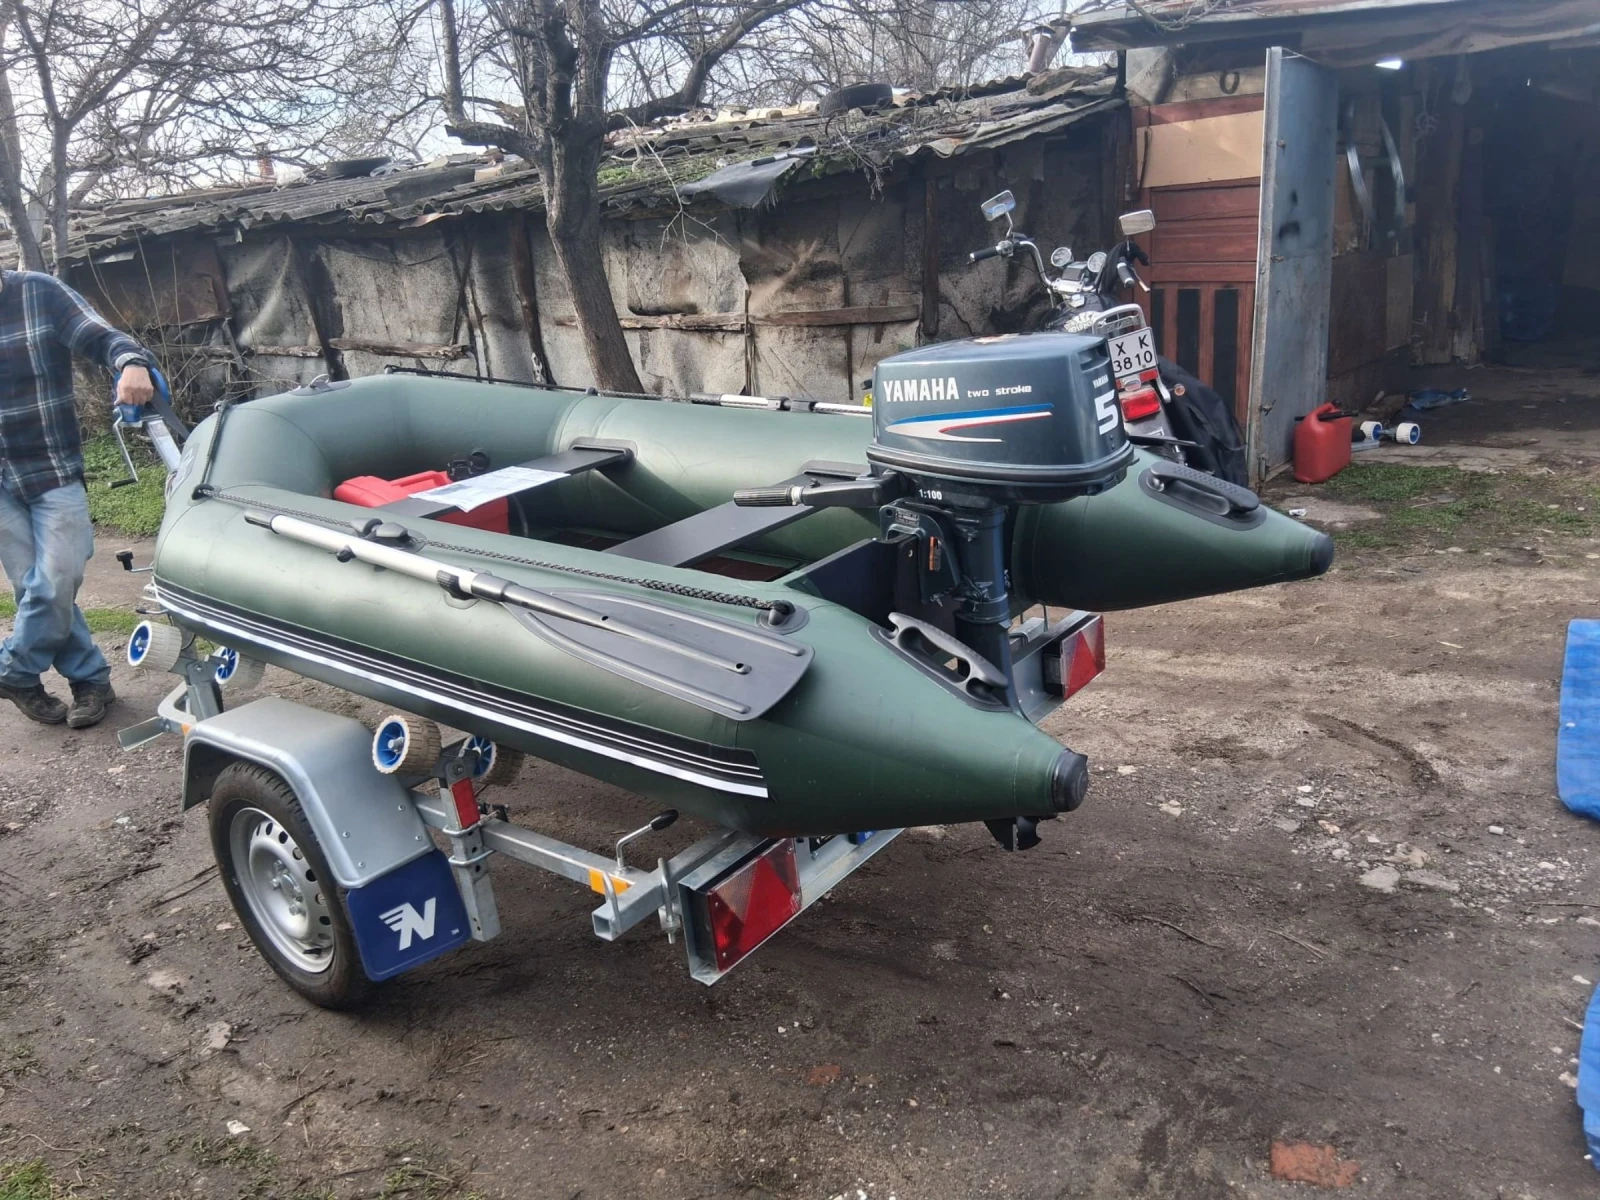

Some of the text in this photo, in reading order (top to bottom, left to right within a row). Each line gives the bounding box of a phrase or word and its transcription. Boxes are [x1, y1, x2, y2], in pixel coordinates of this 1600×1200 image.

[1112, 350, 1153, 373] 3810
[883, 377, 1032, 402] YAMAHA two stroke
[1092, 374, 1109, 389] YAMAHA
[1094, 389, 1119, 435] 5
[919, 489, 943, 500] 1:100
